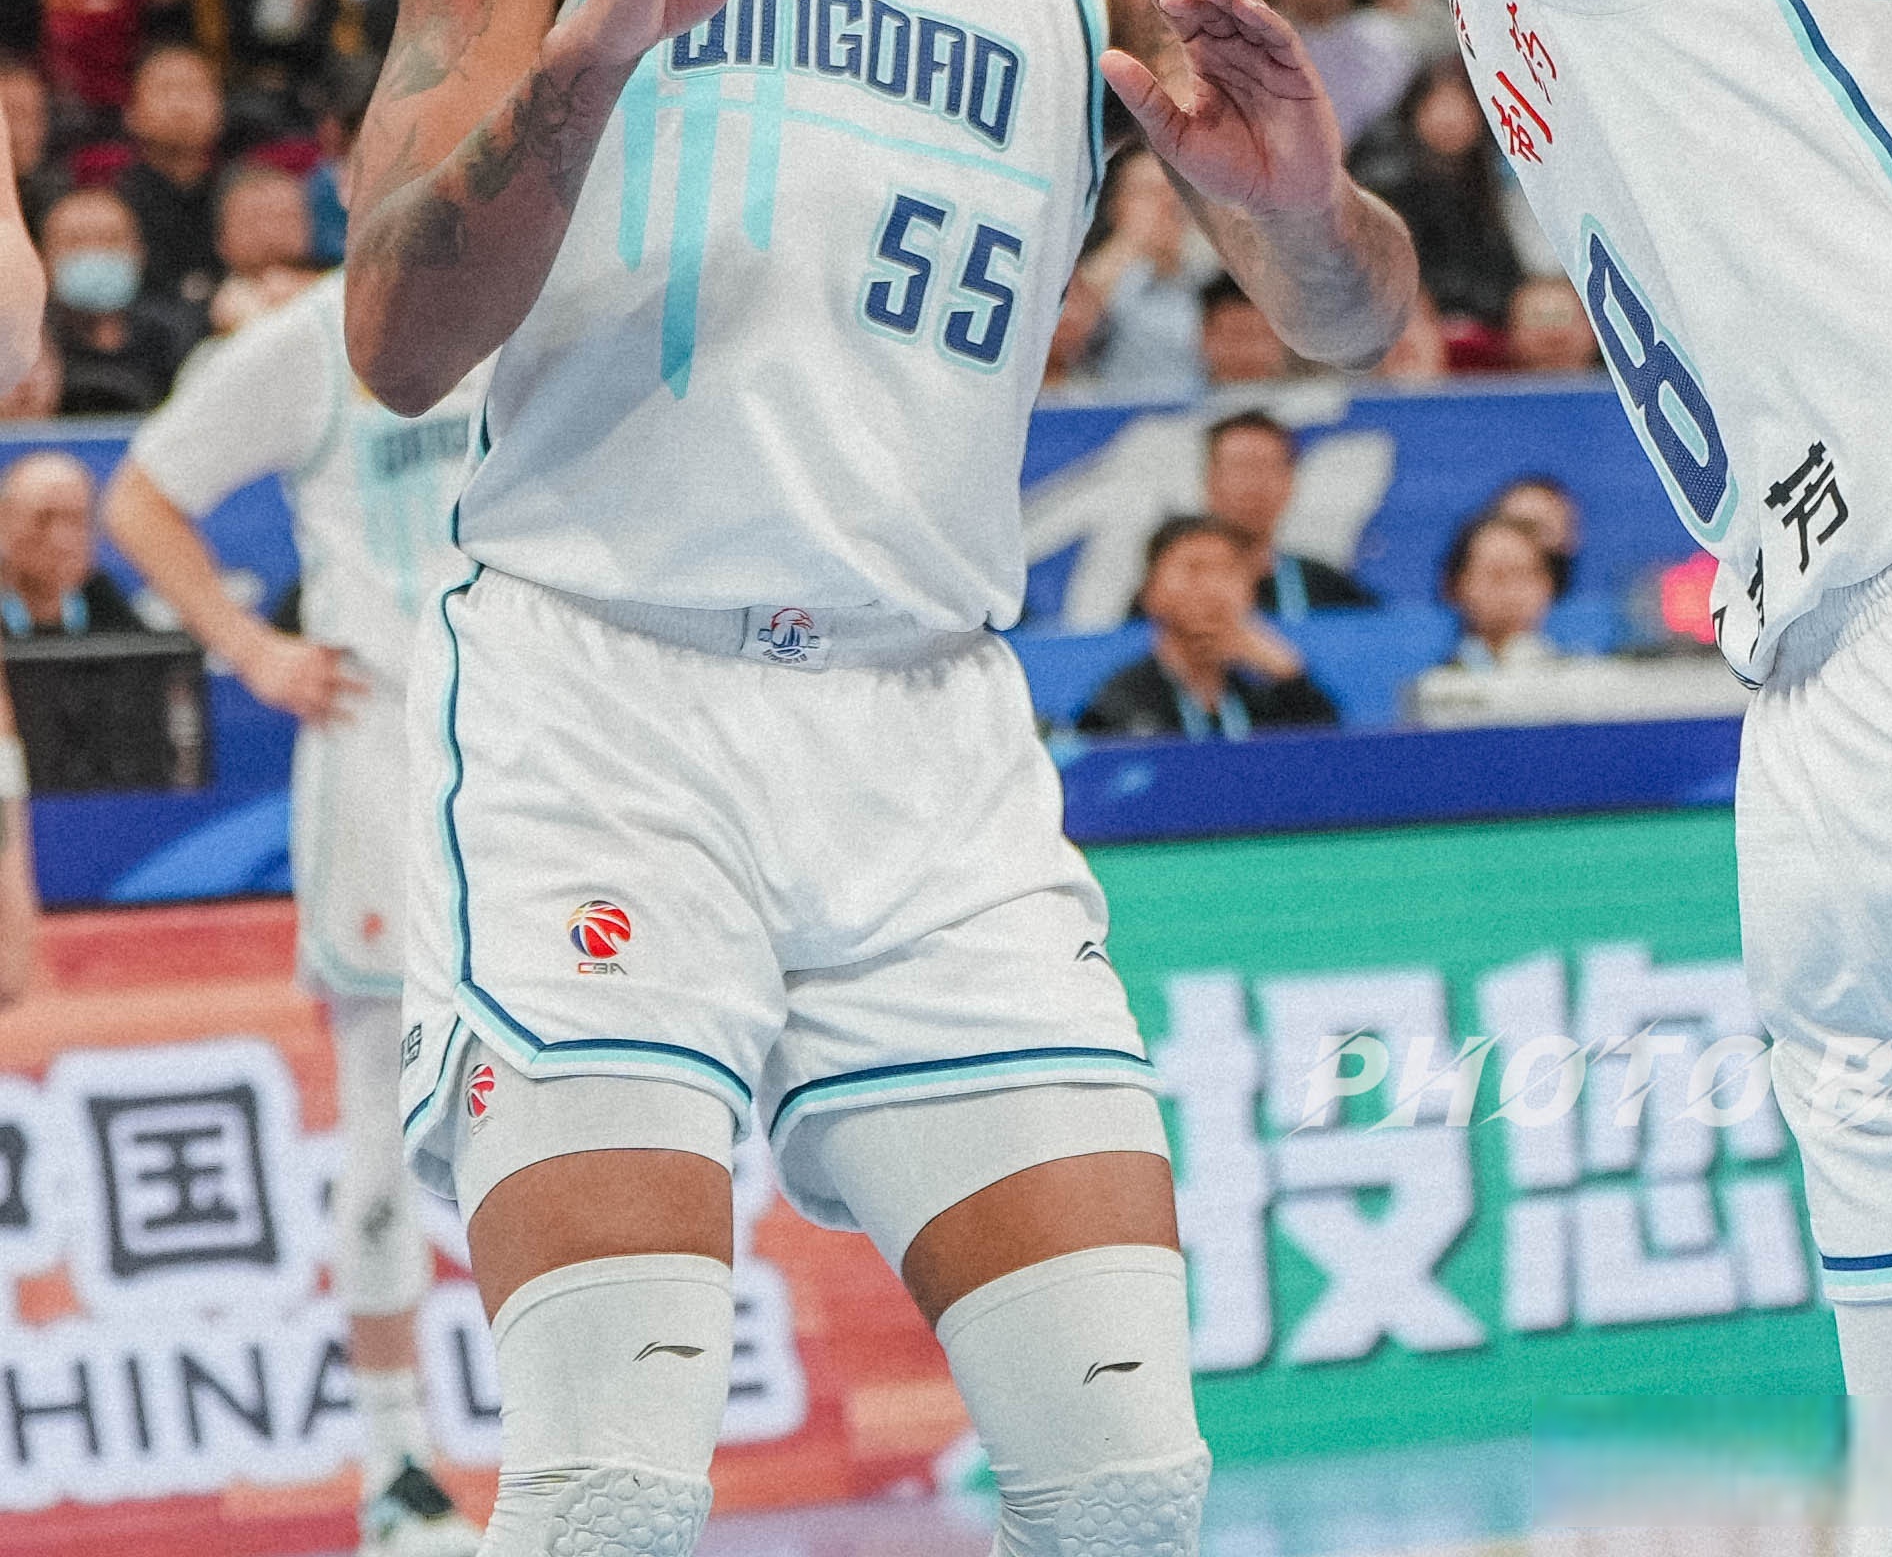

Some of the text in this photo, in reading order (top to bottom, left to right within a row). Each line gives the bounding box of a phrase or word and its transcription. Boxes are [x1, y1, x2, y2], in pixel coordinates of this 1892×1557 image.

[863, 193, 1025, 366] 55
[1584, 232, 1731, 527] 8
[577, 960, 628, 977] CBA
[2, 1338, 354, 1463] HINA
